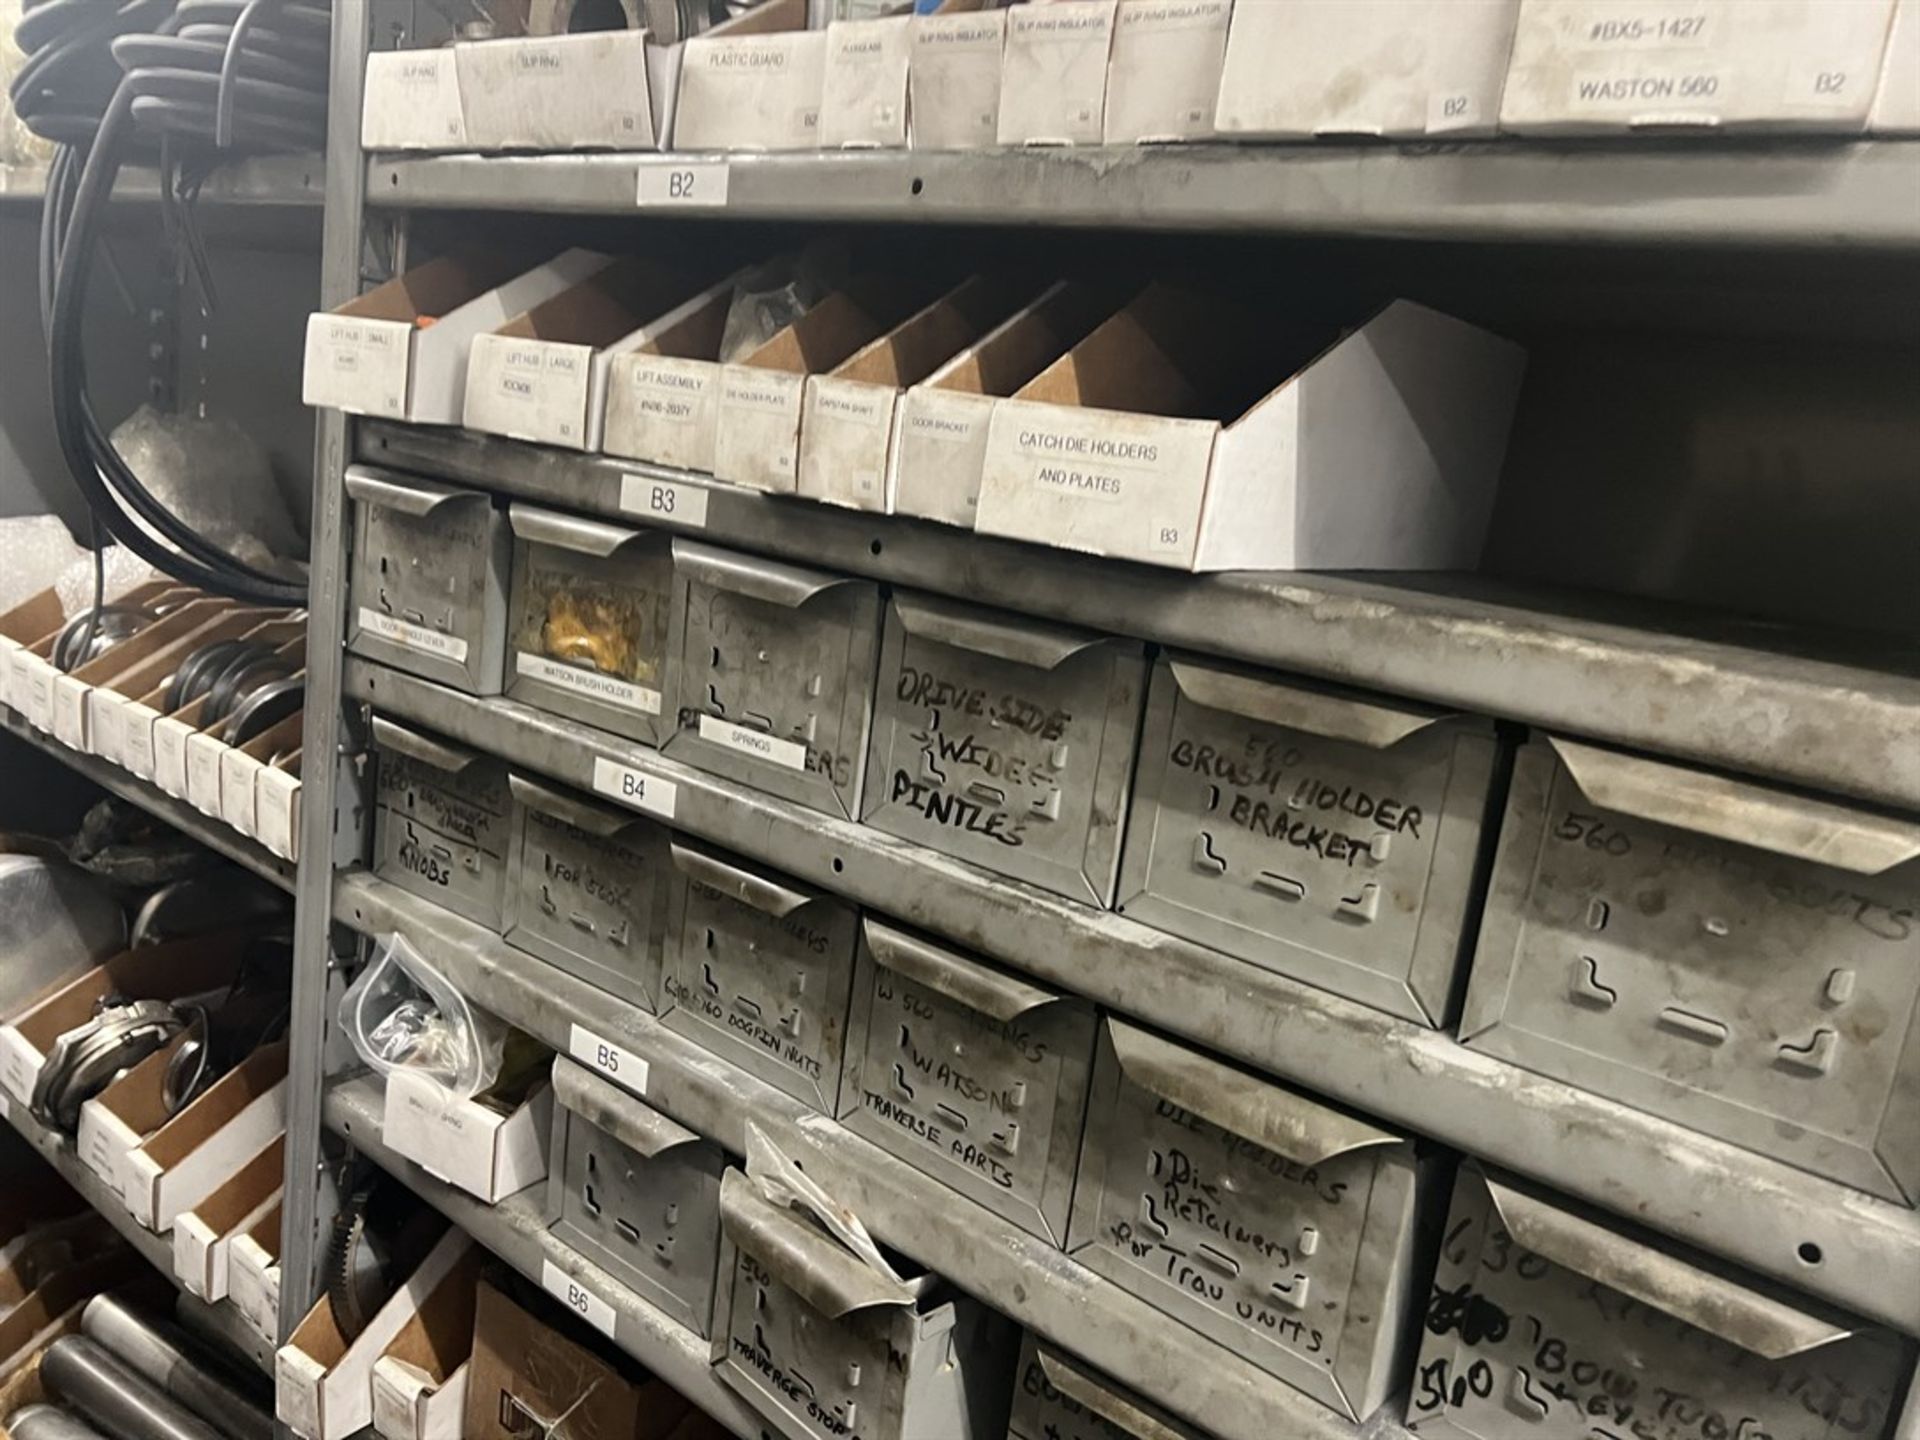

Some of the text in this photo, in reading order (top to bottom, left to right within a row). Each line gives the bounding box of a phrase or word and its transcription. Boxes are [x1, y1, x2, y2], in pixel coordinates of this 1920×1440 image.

[1590, 17, 1706, 40] #BX5-1427
[710, 52, 784, 67] PLASTIC GUARD
[1579, 75, 1720, 100] WASTON 560
[1815, 73, 1847, 94] B2
[1443, 97, 1469, 117] B2
[669, 172, 696, 199] B2
[637, 370, 704, 391] LIFT ASSEMBLY
[1019, 430, 1158, 462] CATCH DIE HOLDERS
[1038, 467, 1121, 494] AND PLATES
[651, 486, 676, 513] B3
[1160, 528, 1179, 545] B3
[731, 730, 772, 754] SPRINGS
[622, 773, 645, 801] B4
[1171, 739, 1422, 840] BRUSH HOLDER
[891, 768, 1026, 847] PINTLES
[1230, 793, 1371, 867] BRACKET
[1554, 811, 1632, 856] 560
[399, 841, 451, 887] KNOBS
[597, 1044, 620, 1073] B5
[784, 1045, 823, 1081] NUTS
[912, 1050, 1010, 1114] WATSON
[863, 1089, 1014, 1189] TRAVERSE PARTS
[567, 1284, 589, 1313] B6
